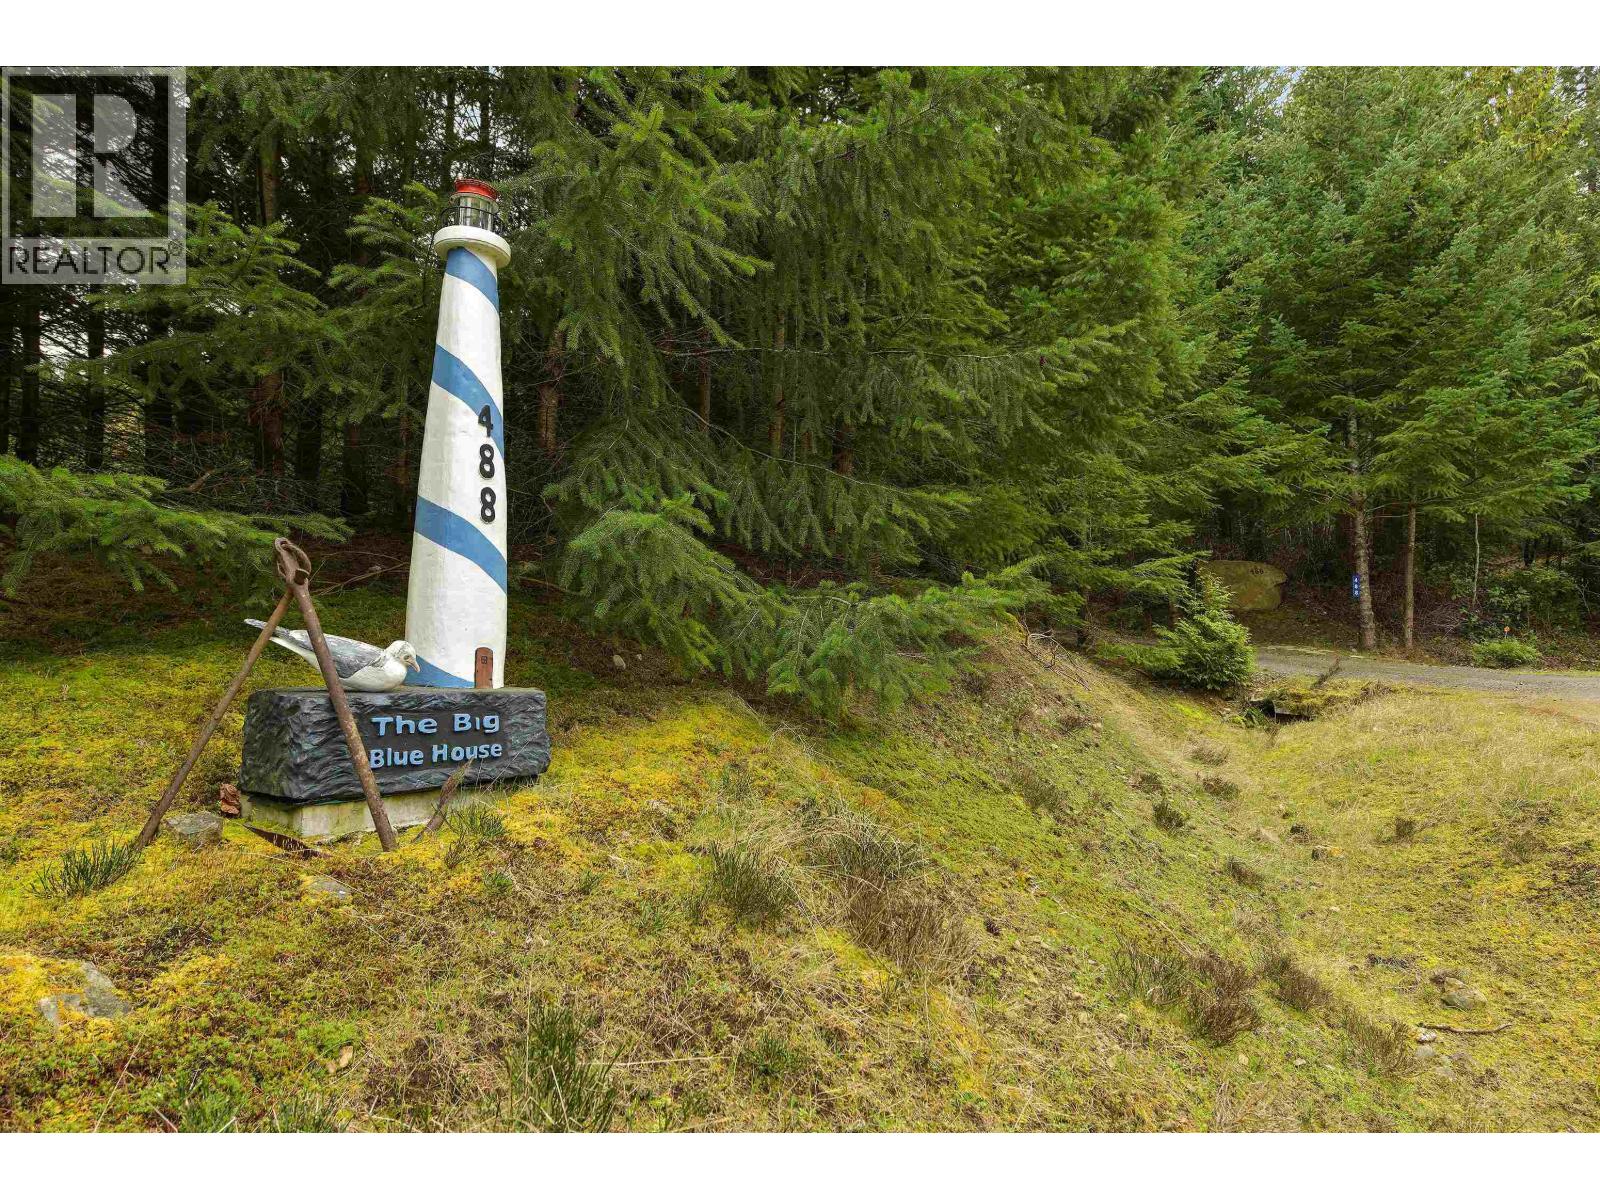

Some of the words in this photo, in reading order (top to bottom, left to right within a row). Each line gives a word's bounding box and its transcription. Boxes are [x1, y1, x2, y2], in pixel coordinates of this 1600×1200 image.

[478, 404, 496, 523] 488
[371, 715, 438, 737] The
[453, 713, 500, 734] Big
[370, 748, 424, 769] Blue
[432, 743, 503, 763] House
